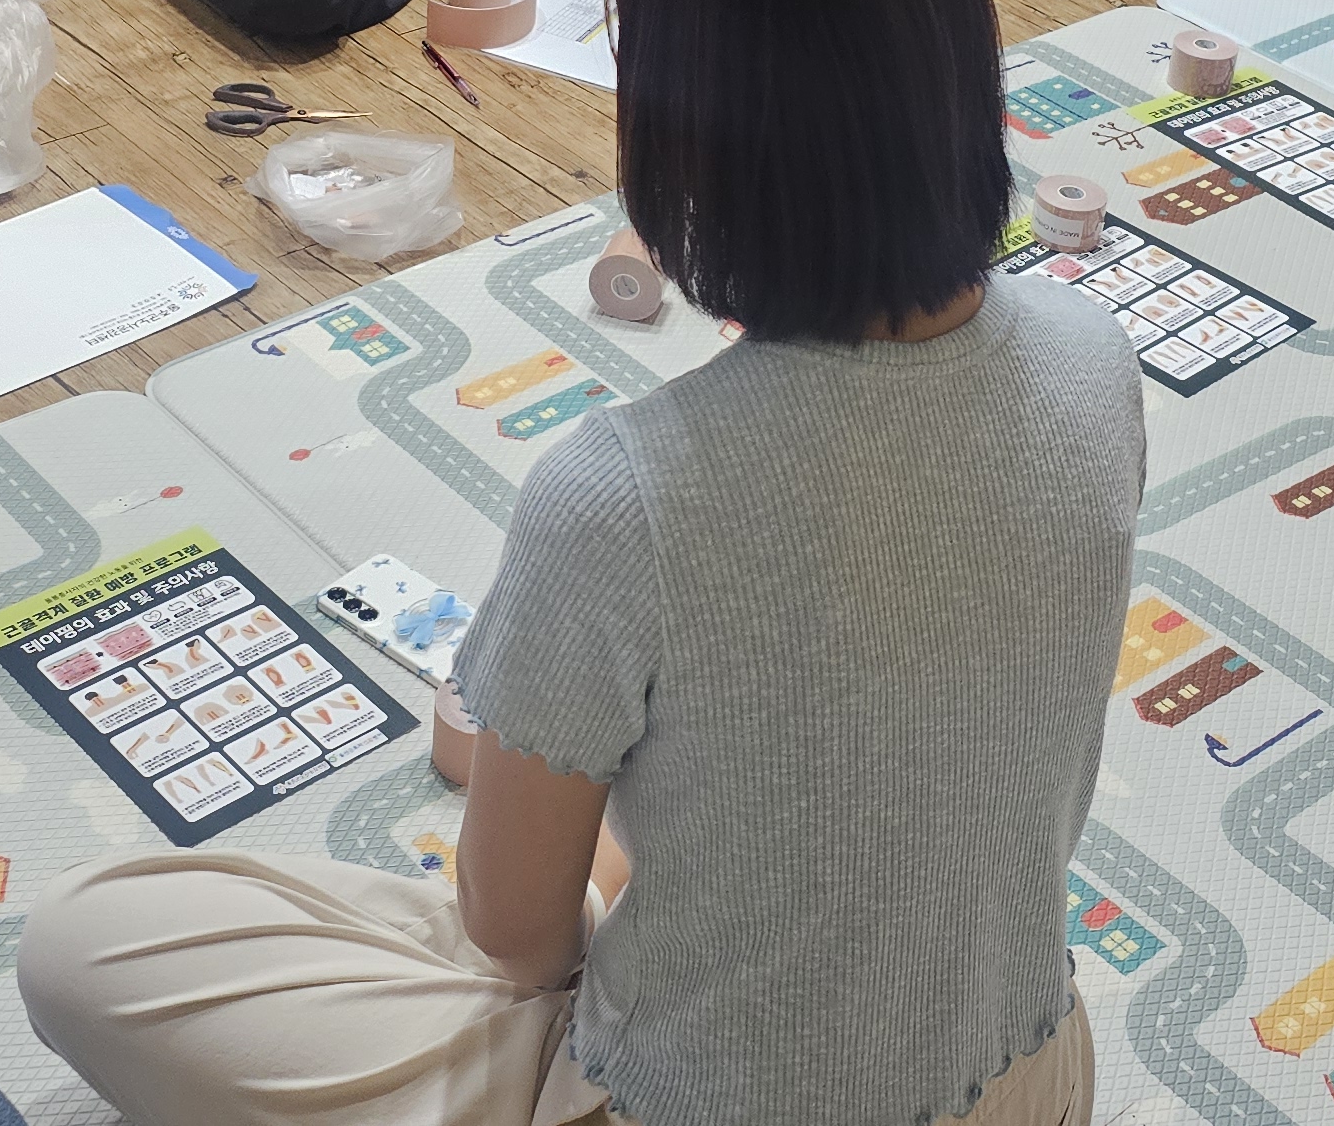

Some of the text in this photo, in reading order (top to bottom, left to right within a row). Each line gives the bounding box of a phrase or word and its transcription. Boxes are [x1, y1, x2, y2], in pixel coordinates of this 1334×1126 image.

[1167, 111, 1211, 128] 테이핑의
[1207, 103, 1231, 116] 효과
[1241, 86, 1280, 103] 주의사항
[1, 544, 204, 639] 근골격계 질환 예방 프로그램
[20, 617, 95, 654] 테이핑의
[94, 600, 132, 623] 효과
[130, 587, 154, 606] 및
[151, 560, 219, 595] 주의사항
